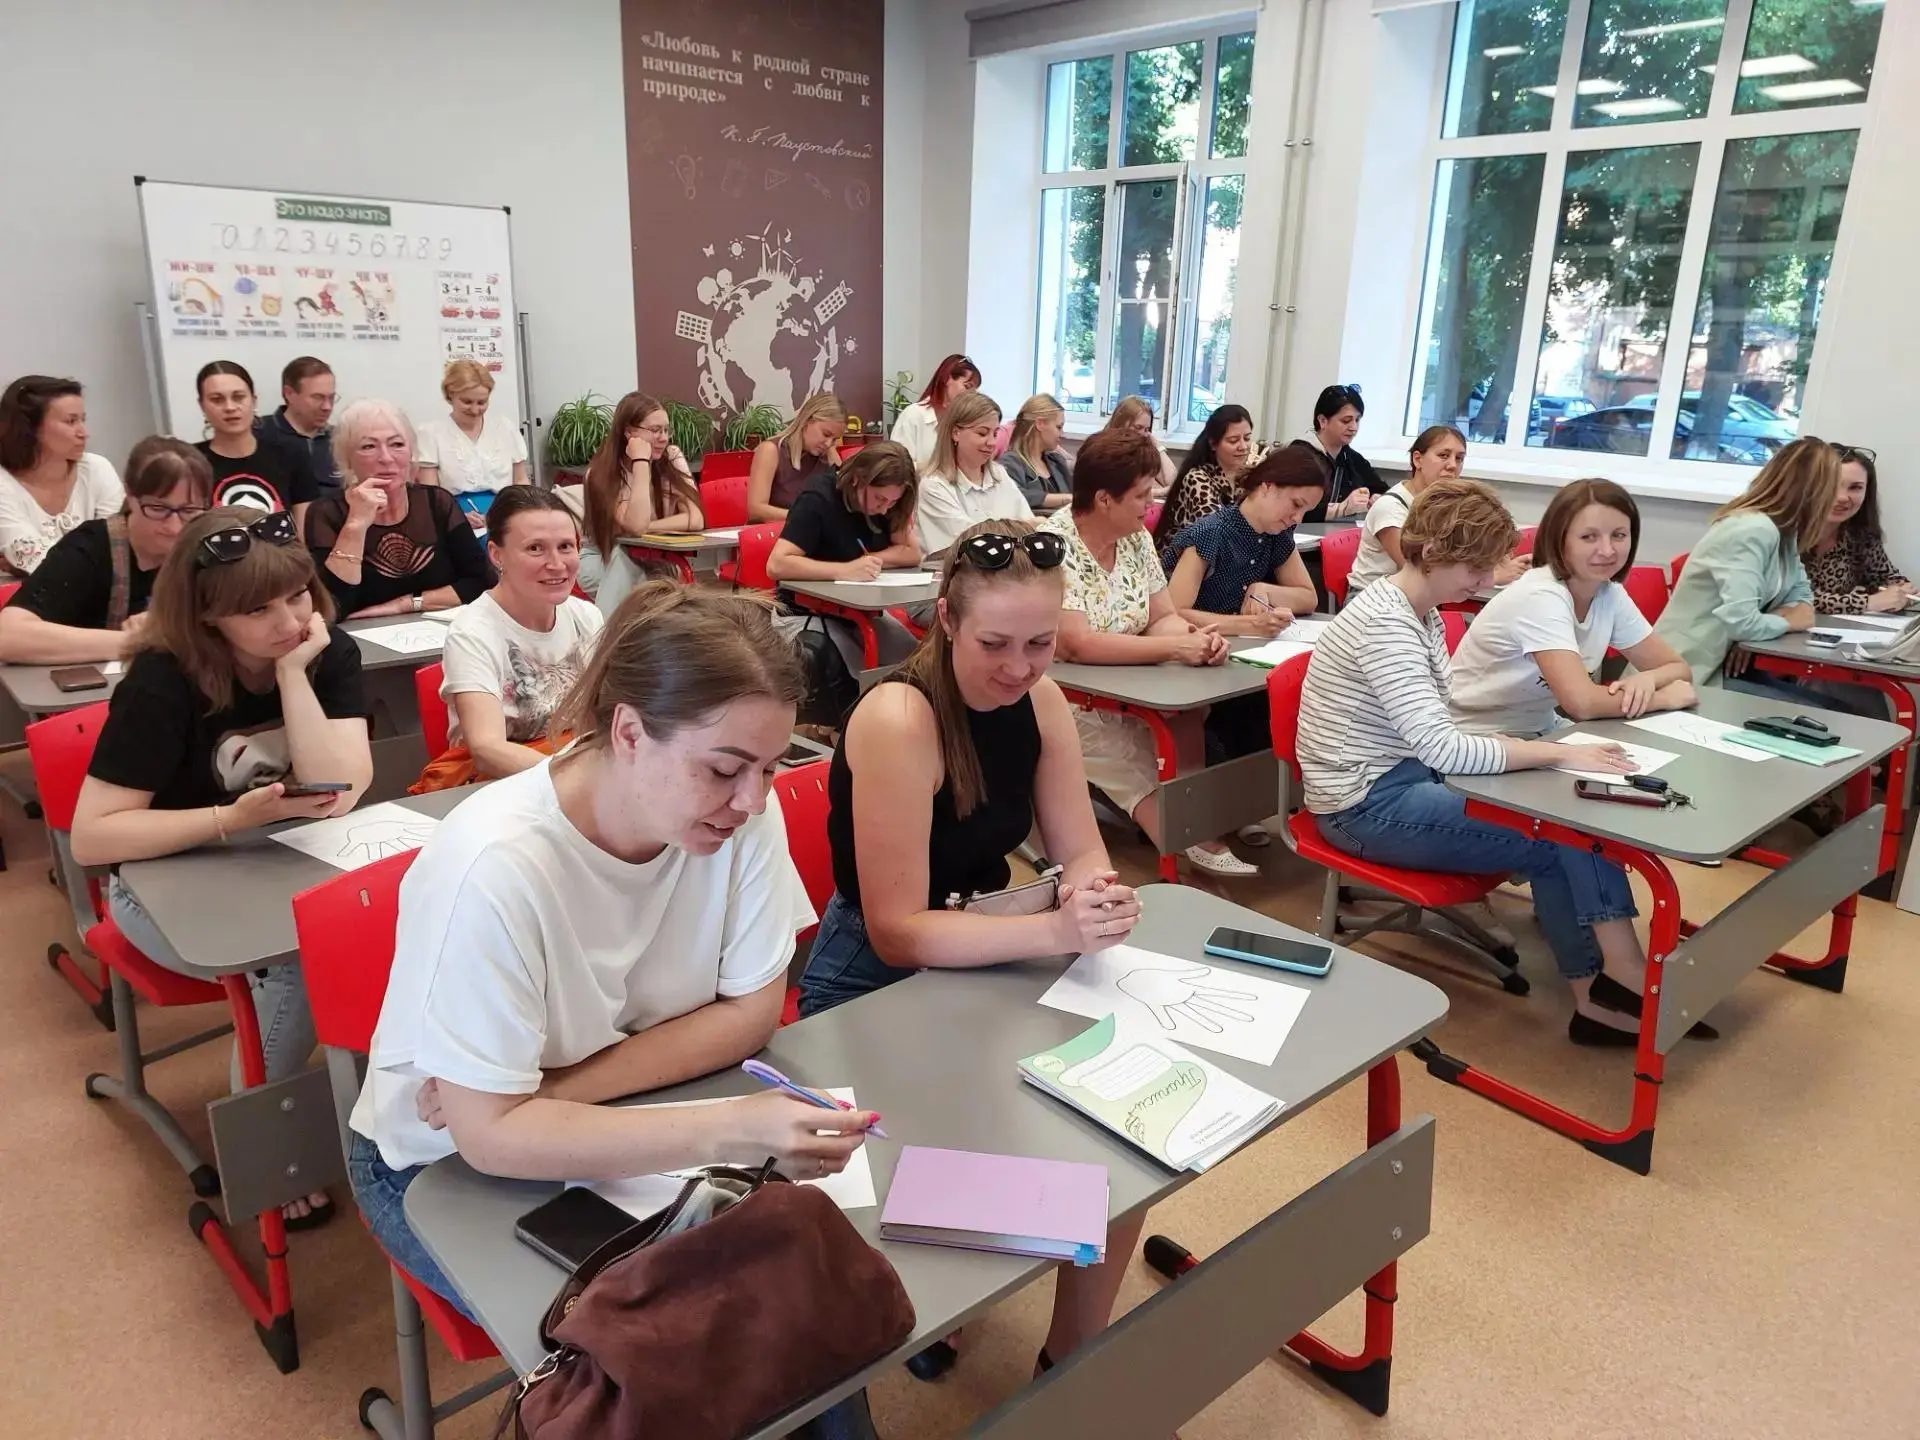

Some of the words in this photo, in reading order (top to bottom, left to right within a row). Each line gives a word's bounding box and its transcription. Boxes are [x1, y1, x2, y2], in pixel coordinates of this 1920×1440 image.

[641, 31, 720, 60] «Любовь
[732, 50, 742, 63] к
[753, 53, 810, 76] родной
[820, 65, 870, 86] стране
[642, 55, 743, 86] начинается
[764, 78, 773, 90] с
[792, 82, 843, 103] любви
[861, 94, 870, 107] к
[642, 77, 727, 104] природе»
[767, 130, 874, 162] Паустовский
